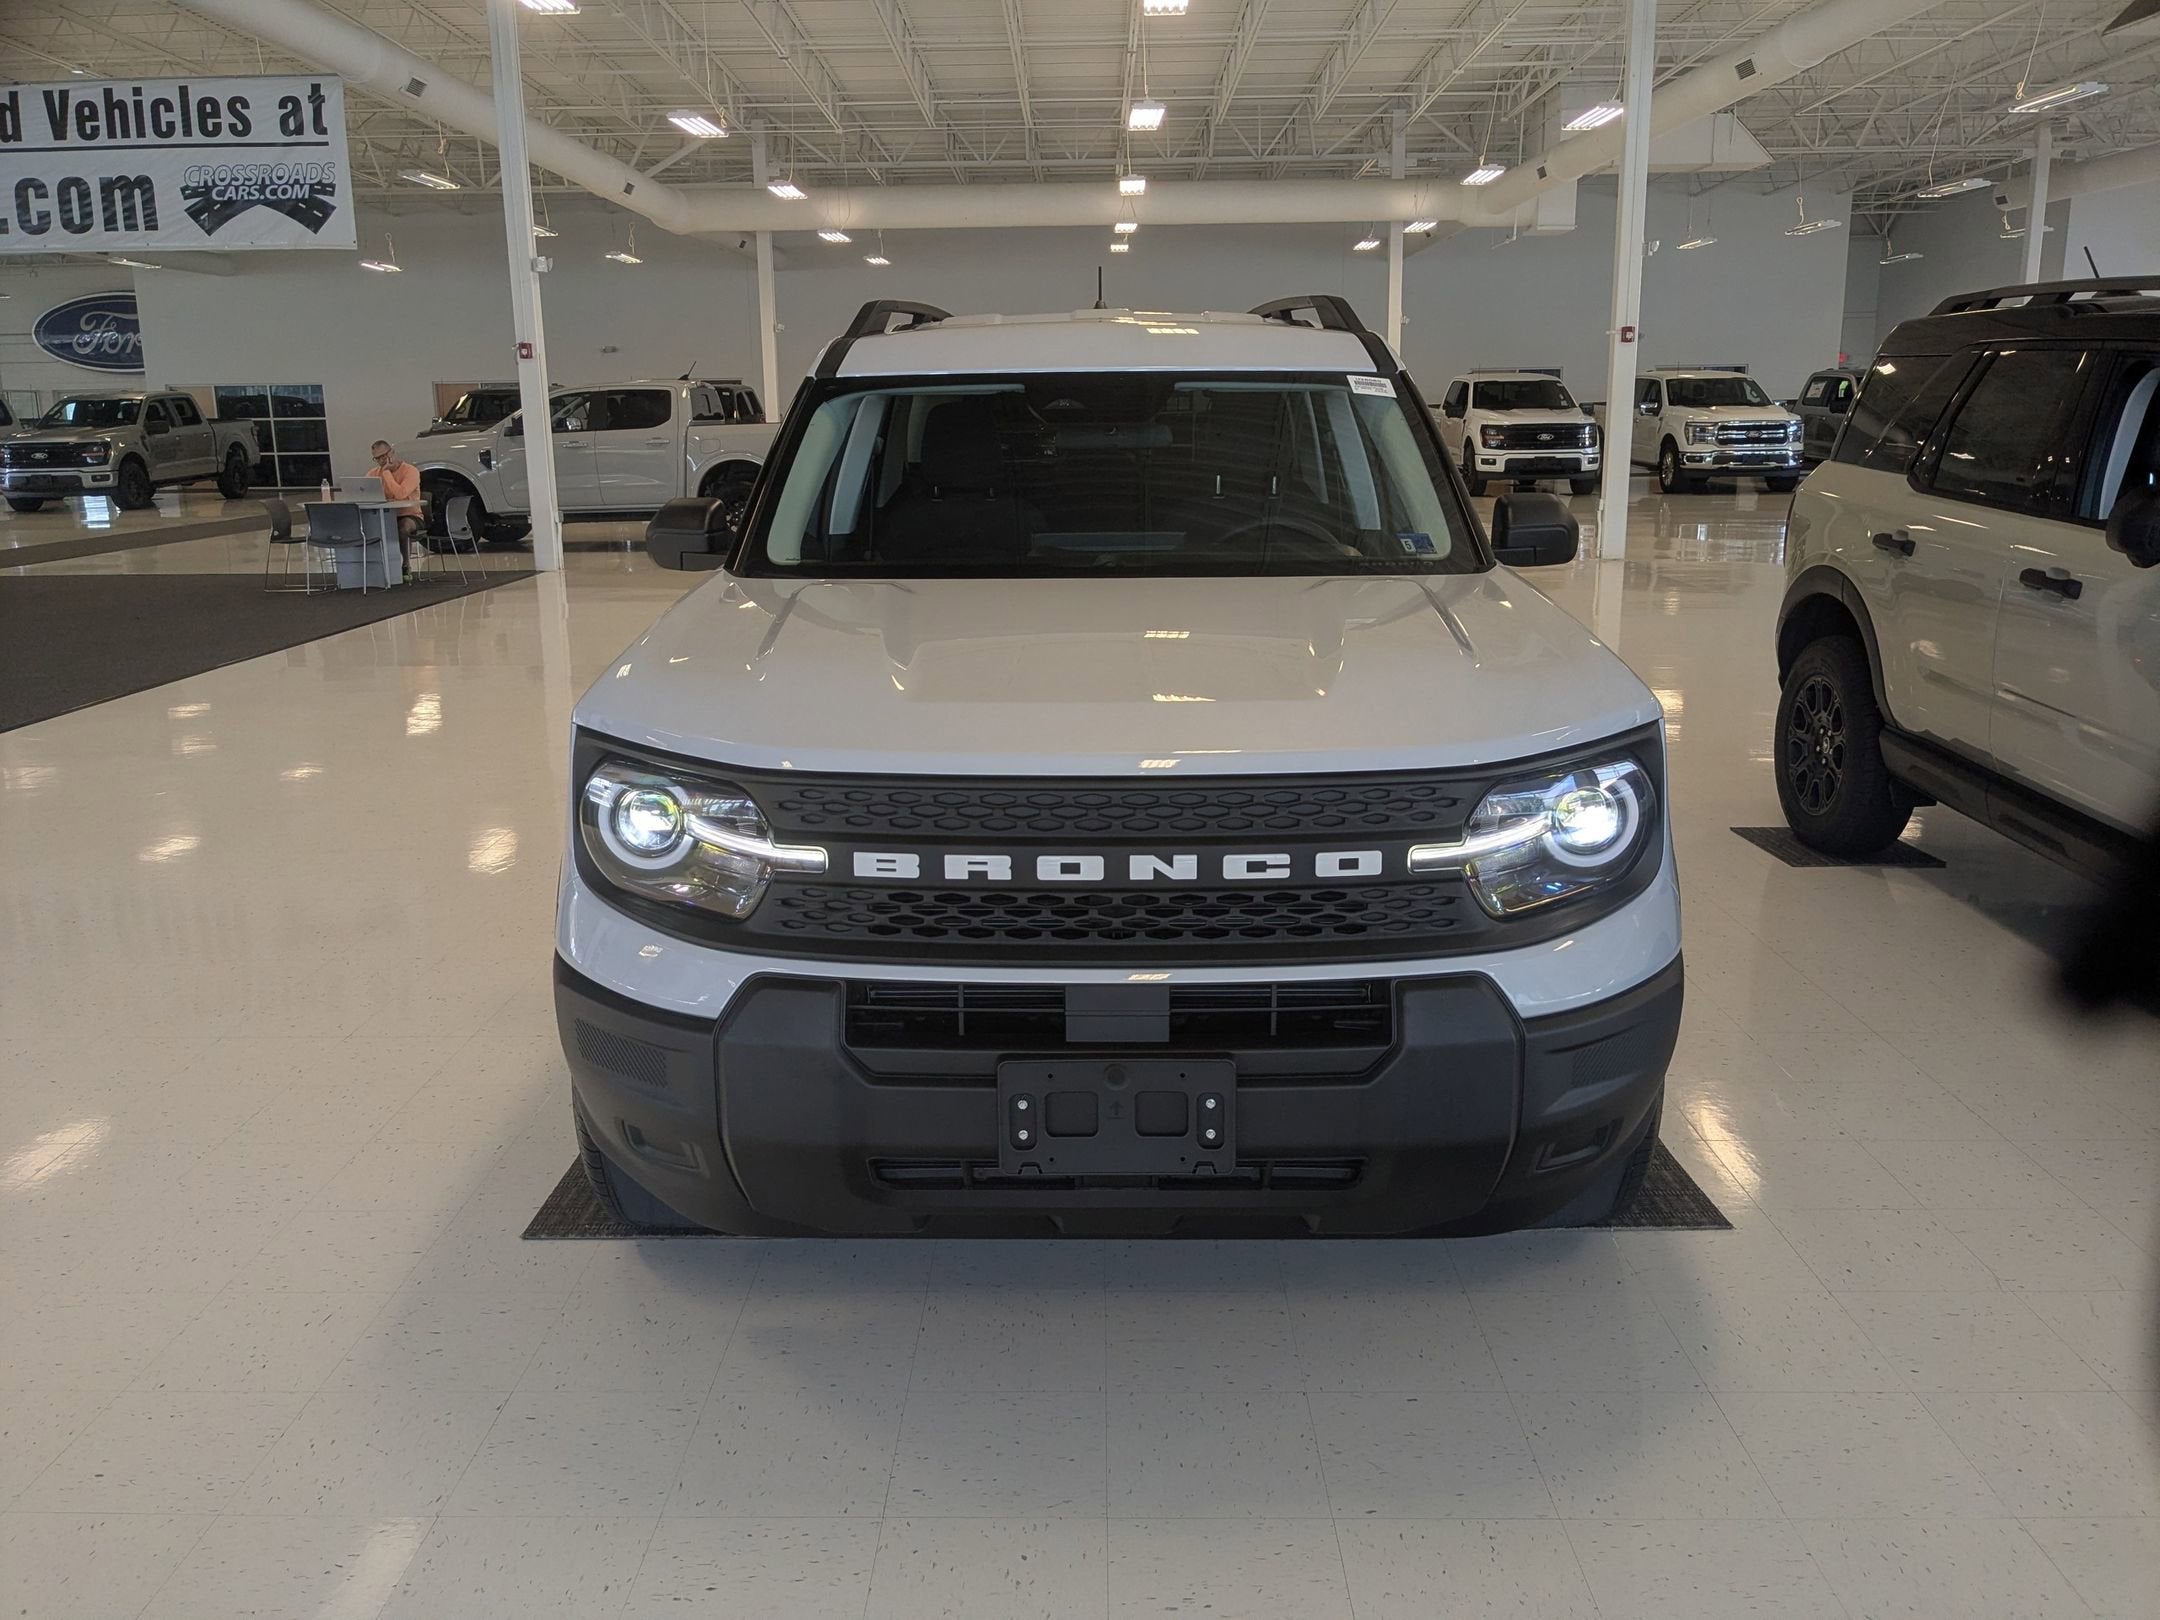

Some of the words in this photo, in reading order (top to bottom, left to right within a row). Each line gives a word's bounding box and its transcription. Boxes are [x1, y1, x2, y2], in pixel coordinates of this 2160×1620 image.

[42, 85, 252, 141] Vehicles
[278, 83, 328, 136] at
[184, 162, 336, 187] CROSSROADS
[211, 184, 311, 201] CARS.COM
[853, 850, 1383, 881] BRONCO
